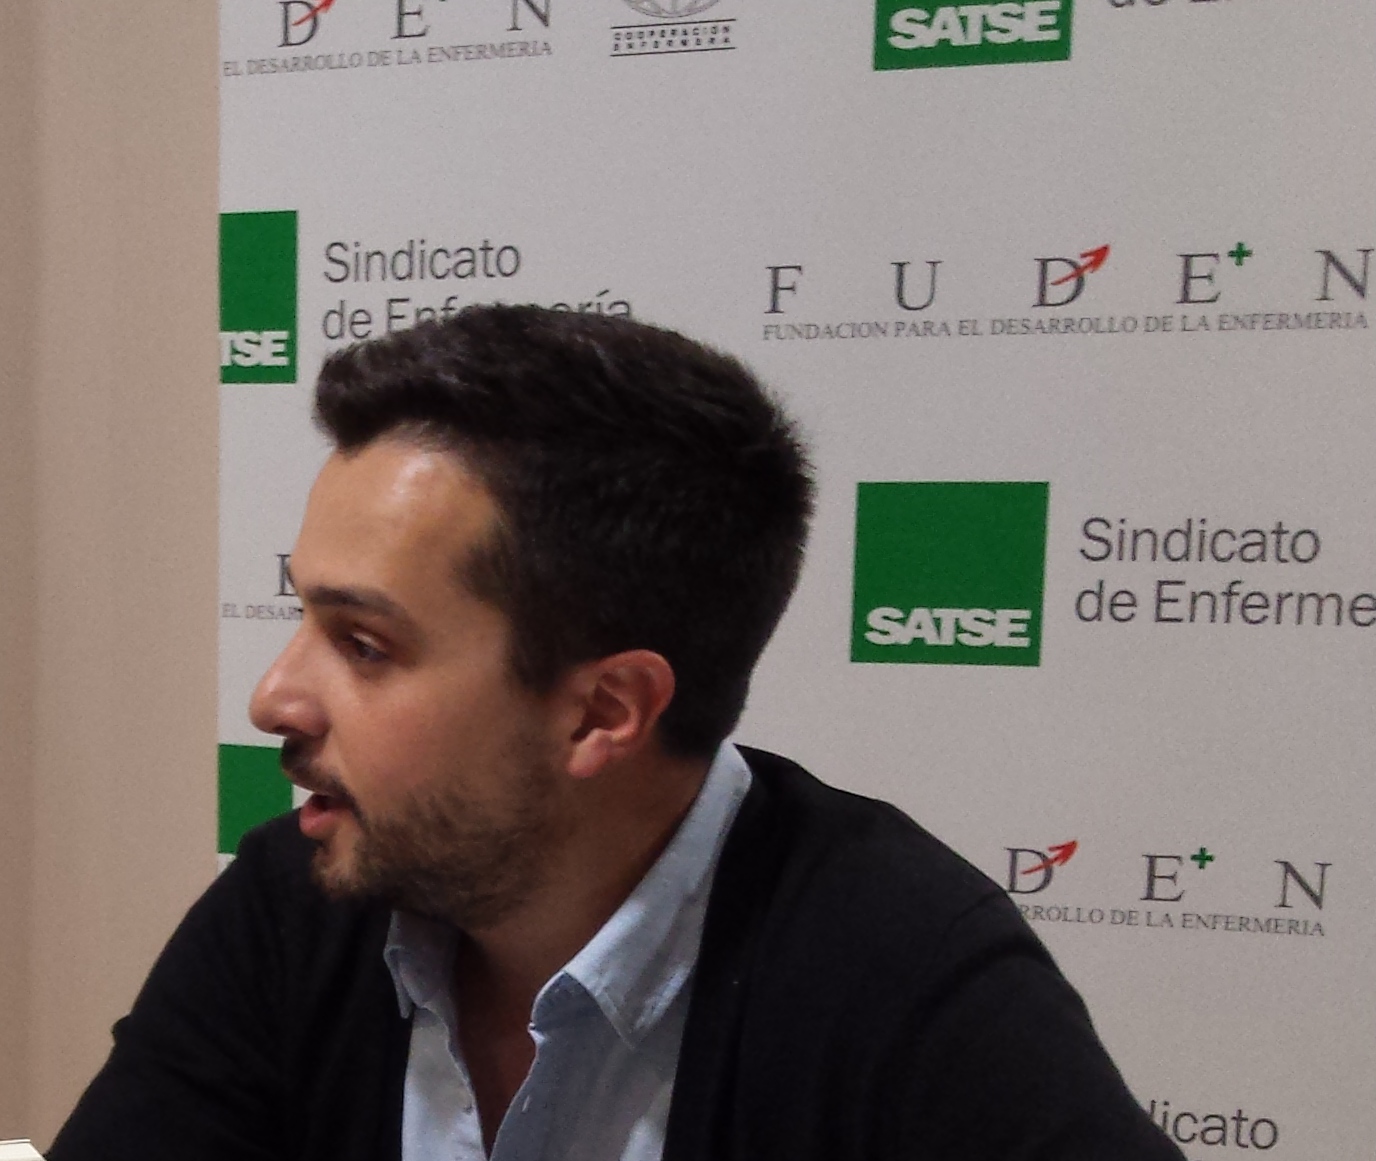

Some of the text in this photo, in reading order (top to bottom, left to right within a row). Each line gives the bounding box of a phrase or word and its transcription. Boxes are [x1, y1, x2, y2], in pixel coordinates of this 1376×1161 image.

[888, 1, 1061, 49] SATSE
[223, 61, 241, 77] EL
[247, 50, 360, 76] DESARROLLO
[367, 51, 391, 68] DE
[397, 48, 421, 65] LA
[323, 239, 521, 284] Sindicato
[321, 300, 373, 341] de
[763, 312, 1369, 341] FUNDACION PARA EL DESARROLLO DE LA ENFERMERIA
[1079, 517, 1321, 564] Sindicato
[1075, 580, 1136, 623] de
[864, 607, 1031, 648] SATSE
[1111, 909, 1139, 927] DE
[1146, 911, 1173, 928] LA
[1182, 912, 1325, 937] ENFERMERIA
